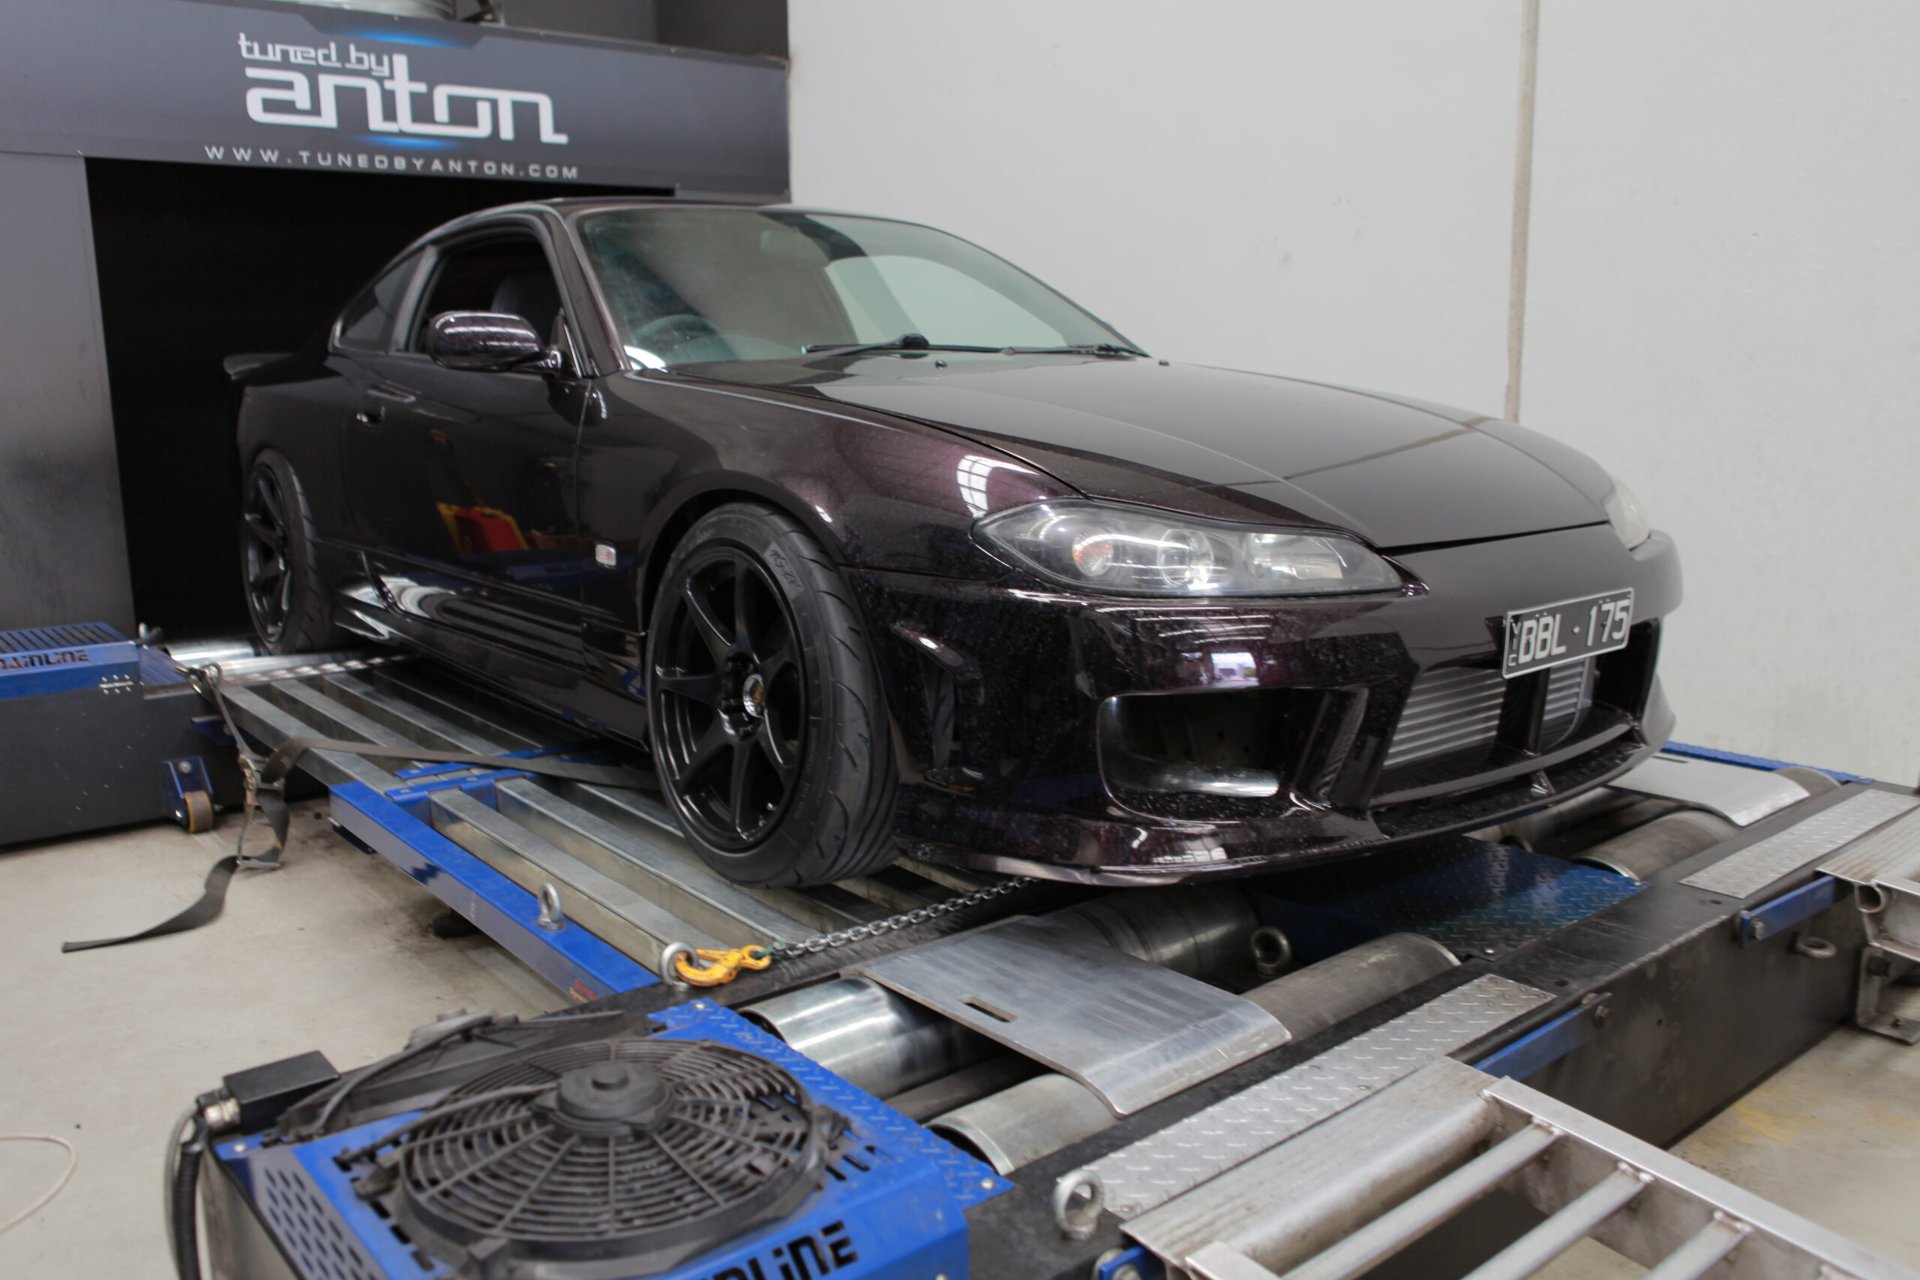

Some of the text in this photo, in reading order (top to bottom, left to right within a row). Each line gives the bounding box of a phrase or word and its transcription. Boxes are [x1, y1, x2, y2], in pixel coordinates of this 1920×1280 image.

[238, 32, 390, 77] tuned by
[244, 53, 569, 145] anton
[204, 145, 578, 179] WWW.TUNEDBYANTON.COM
